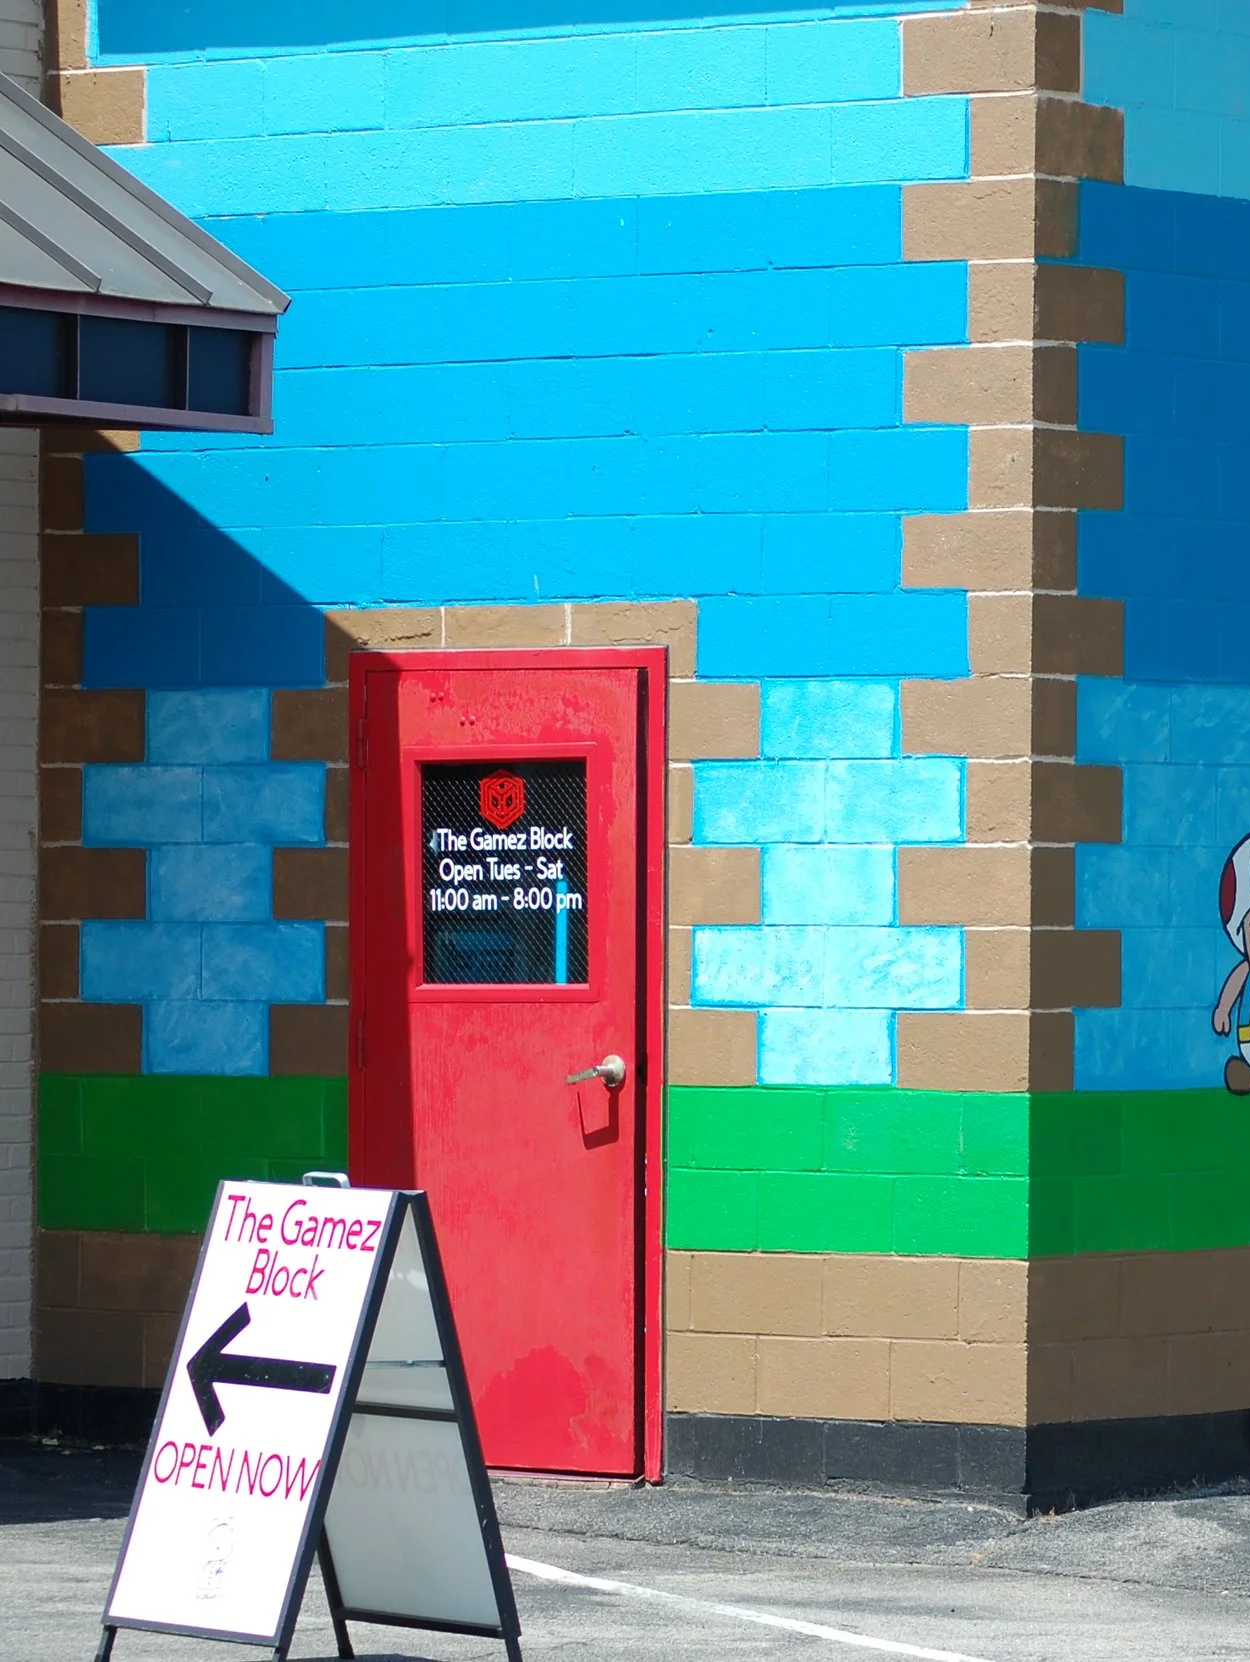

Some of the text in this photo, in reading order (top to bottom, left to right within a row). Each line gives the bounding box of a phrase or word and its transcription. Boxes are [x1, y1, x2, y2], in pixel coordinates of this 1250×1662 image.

[437, 826, 573, 851] The Gamez Block
[439, 857, 483, 885] Open
[486, 857, 521, 880] Tues
[536, 856, 563, 880] Sat
[430, 888, 469, 911] 11:00
[472, 894, 498, 911] am
[513, 887, 552, 910] 8:00
[556, 891, 582, 914] pm
[224, 1194, 383, 1252] The Gamez
[245, 1248, 326, 1301] Block
[154, 1440, 323, 1502] OPEN NOW
